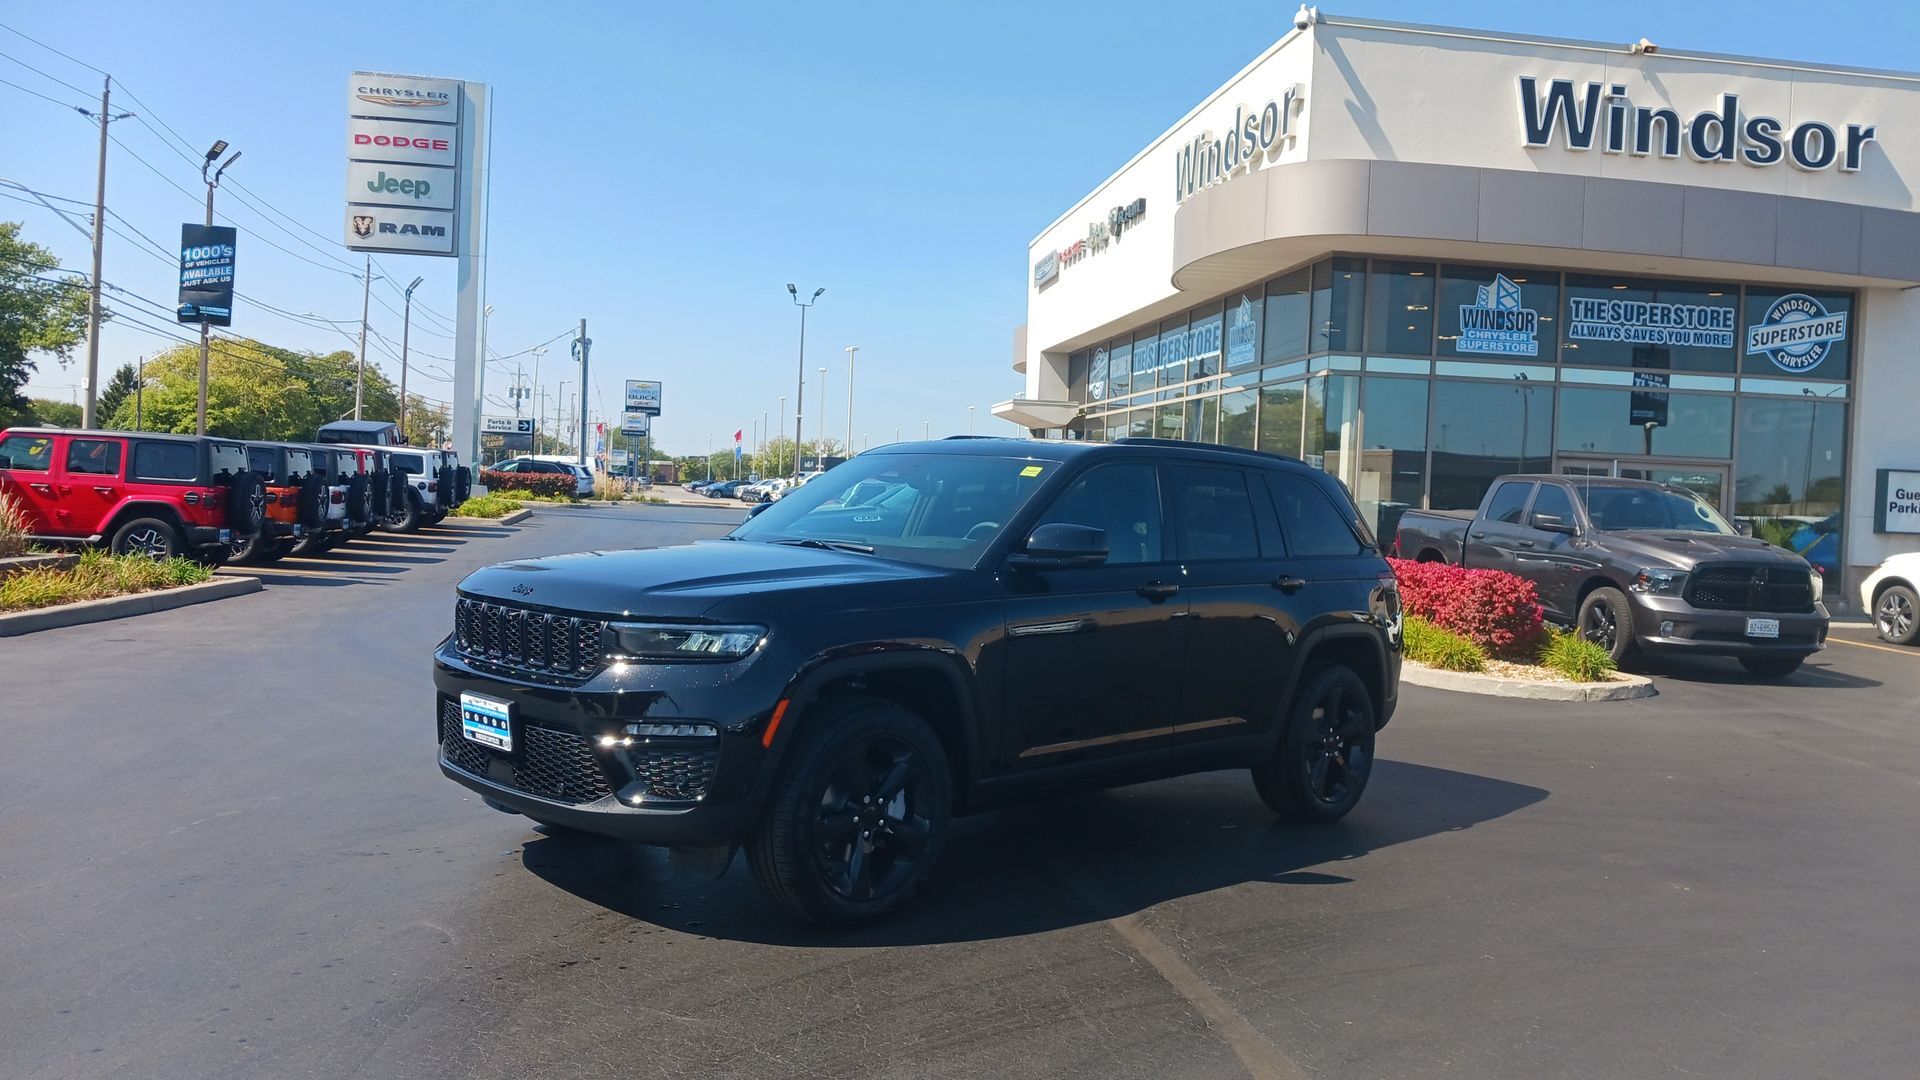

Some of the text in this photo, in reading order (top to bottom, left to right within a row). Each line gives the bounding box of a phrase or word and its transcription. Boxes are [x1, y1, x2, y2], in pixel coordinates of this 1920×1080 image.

[358, 86, 449, 99] CHRYSLER
[1516, 75, 1877, 172] Windsor
[354, 134, 449, 150] DODGE
[1176, 84, 1300, 204] Windsor
[367, 171, 431, 199] Jeep
[378, 222, 446, 237] RAM
[183, 245, 233, 261] 1000's
[196, 258, 230, 267] VEHICLES
[182, 266, 233, 280] AVAILABLE
[183, 275, 231, 287] JUST ASK US
[1572, 299, 1733, 329] THE SUPERSTORE
[1771, 299, 1817, 320] WINDSOR
[1462, 308, 1535, 333] WINDSOR
[1468, 330, 1528, 341] CHRYSLER
[1572, 325, 1732, 346] ALWAYS SAVES YOU MORE!
[1752, 320, 1843, 347] SUPERSTORE
[1460, 340, 1535, 352] SUPERSTORE
[1777, 344, 1823, 367] CHRYSLER
